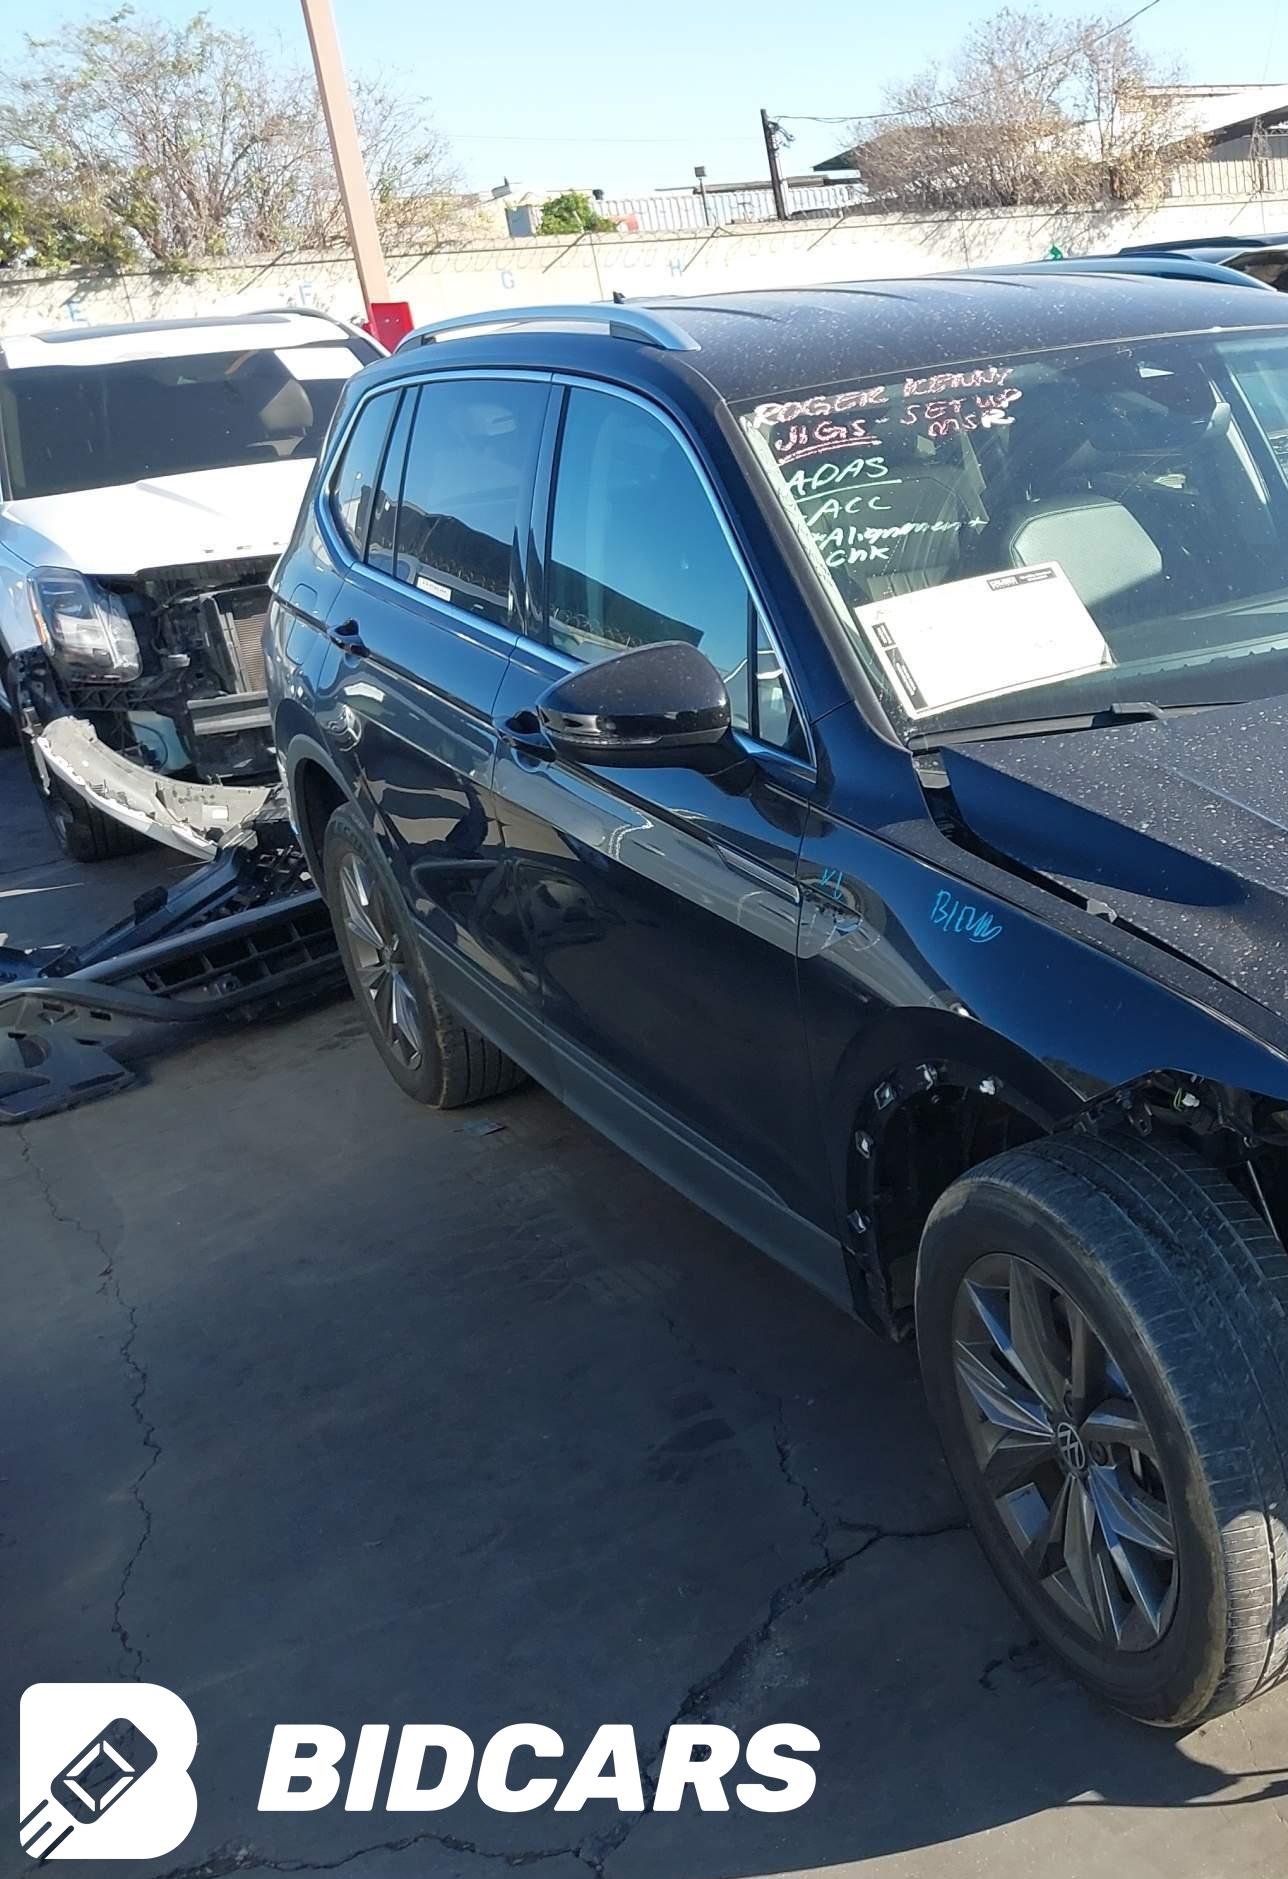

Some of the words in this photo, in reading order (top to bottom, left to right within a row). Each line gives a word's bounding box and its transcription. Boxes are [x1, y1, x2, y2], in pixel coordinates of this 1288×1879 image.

[753, 385, 889, 429] ROGER
[774, 419, 866, 451] JIGS
[900, 398, 967, 425] SET
[976, 388, 1023, 409] UP
[785, 456, 889, 496] ADAS
[807, 496, 893, 526] ACC
